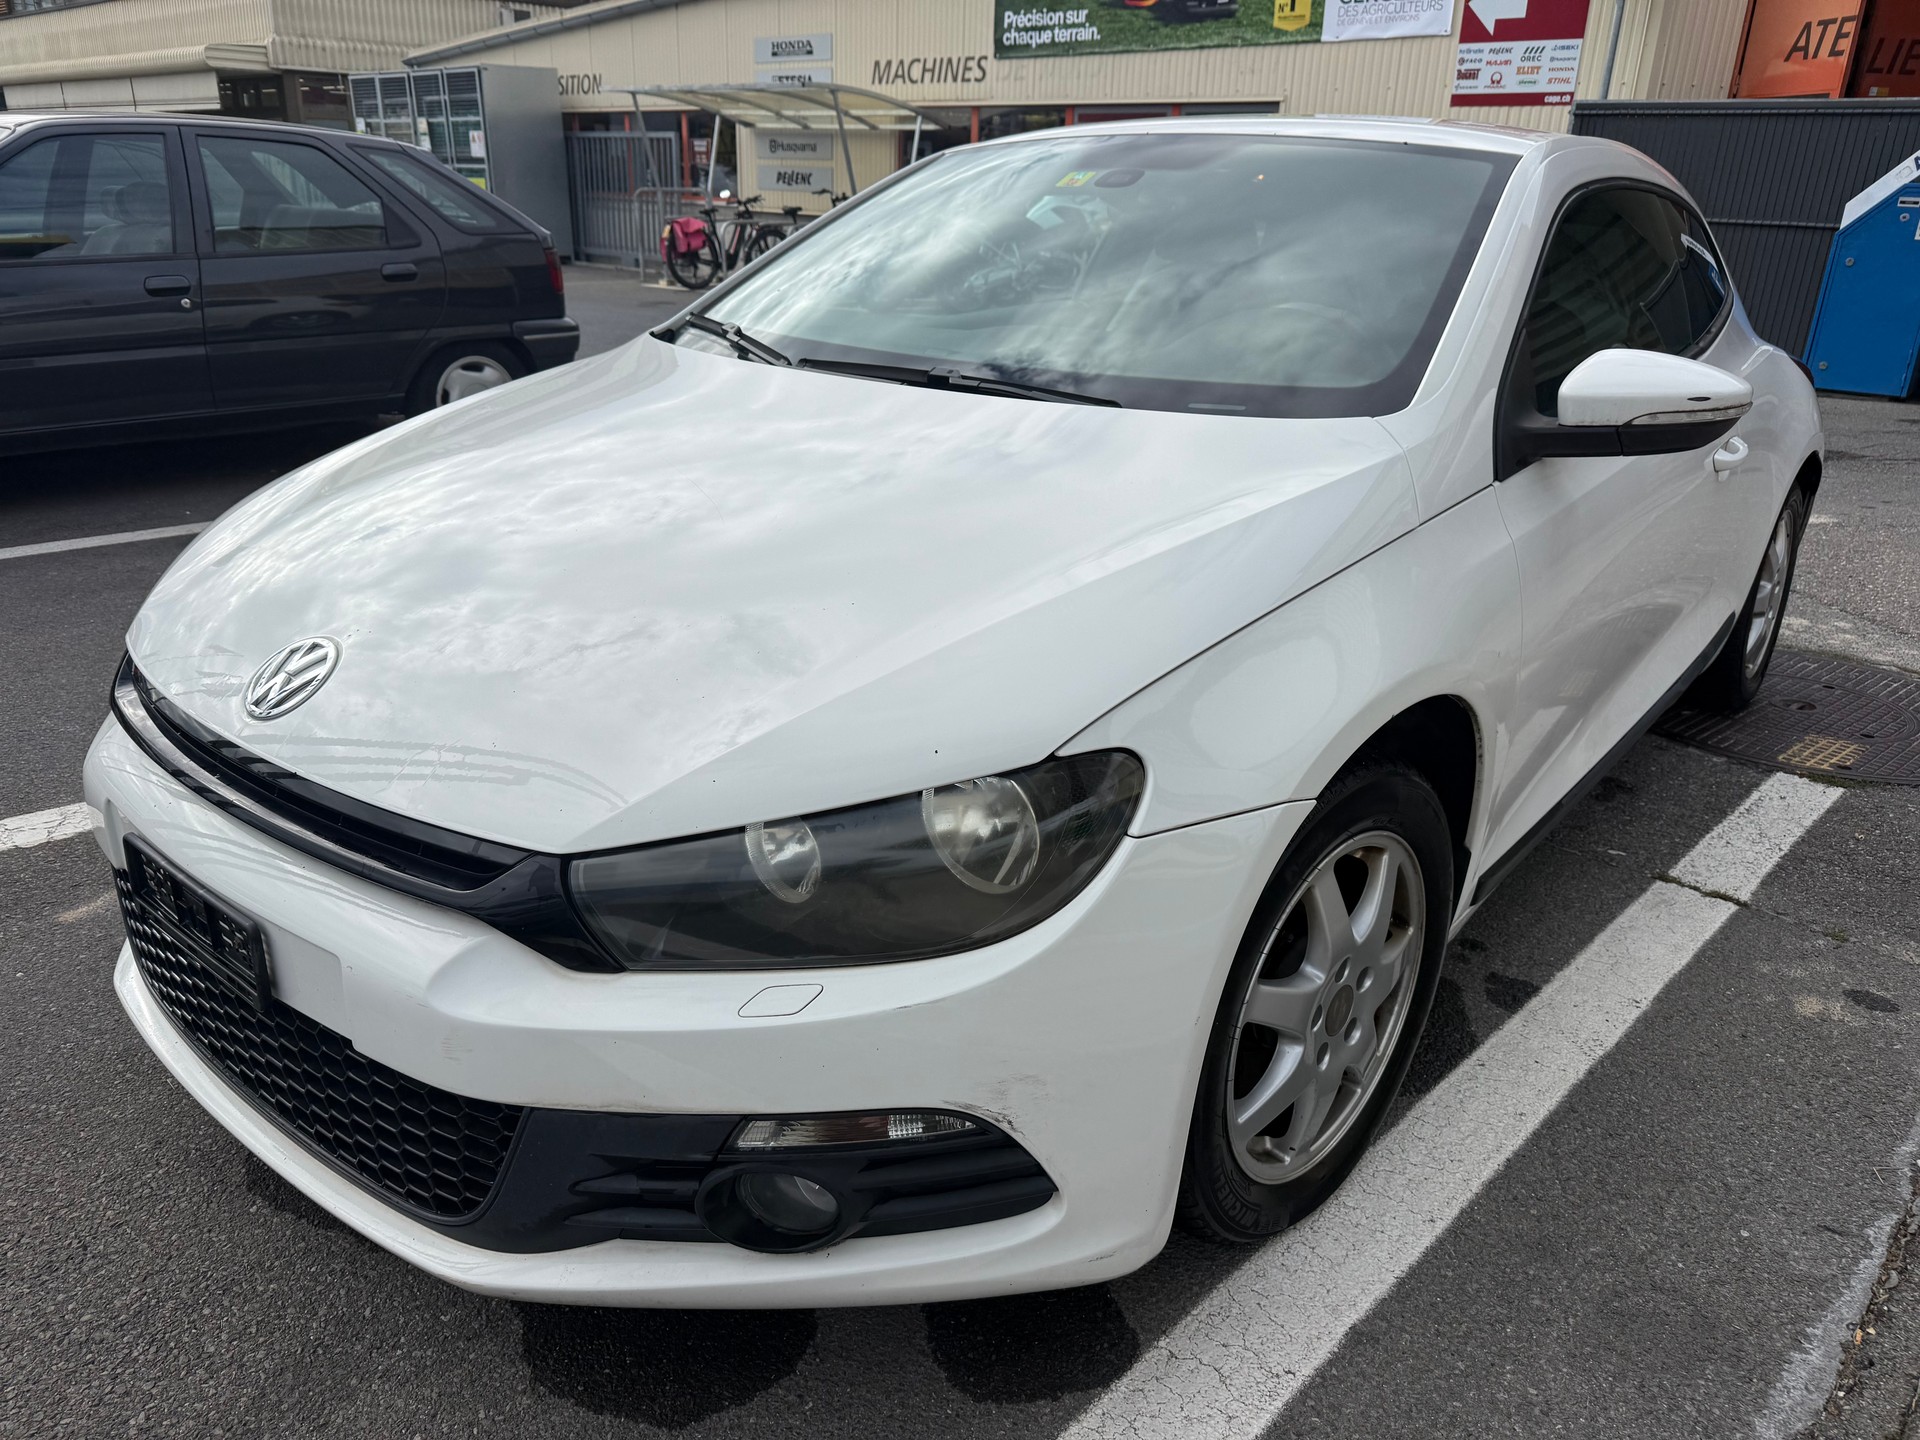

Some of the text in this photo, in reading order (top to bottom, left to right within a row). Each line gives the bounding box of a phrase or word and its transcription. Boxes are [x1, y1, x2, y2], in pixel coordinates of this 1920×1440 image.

[1004, 8, 1089, 29] Précision sur
[1338, 0, 1444, 18] DES AGRICULTEURS
[1337, 18, 1346, 26] DE
[1375, 16, 1384, 24] ET
[1385, 14, 1420, 23] ENVIRONS
[771, 39, 813, 50] HONDA
[1003, 22, 1101, 48] chaque terrain.
[1783, 15, 1858, 62] ATE
[871, 55, 988, 85] MACHINES
[558, 73, 602, 96] SITION
[1546, 77, 1572, 85] STIHL
[776, 170, 813, 186] PELLENC
[1214, 1156, 1258, 1228] MICHELI
